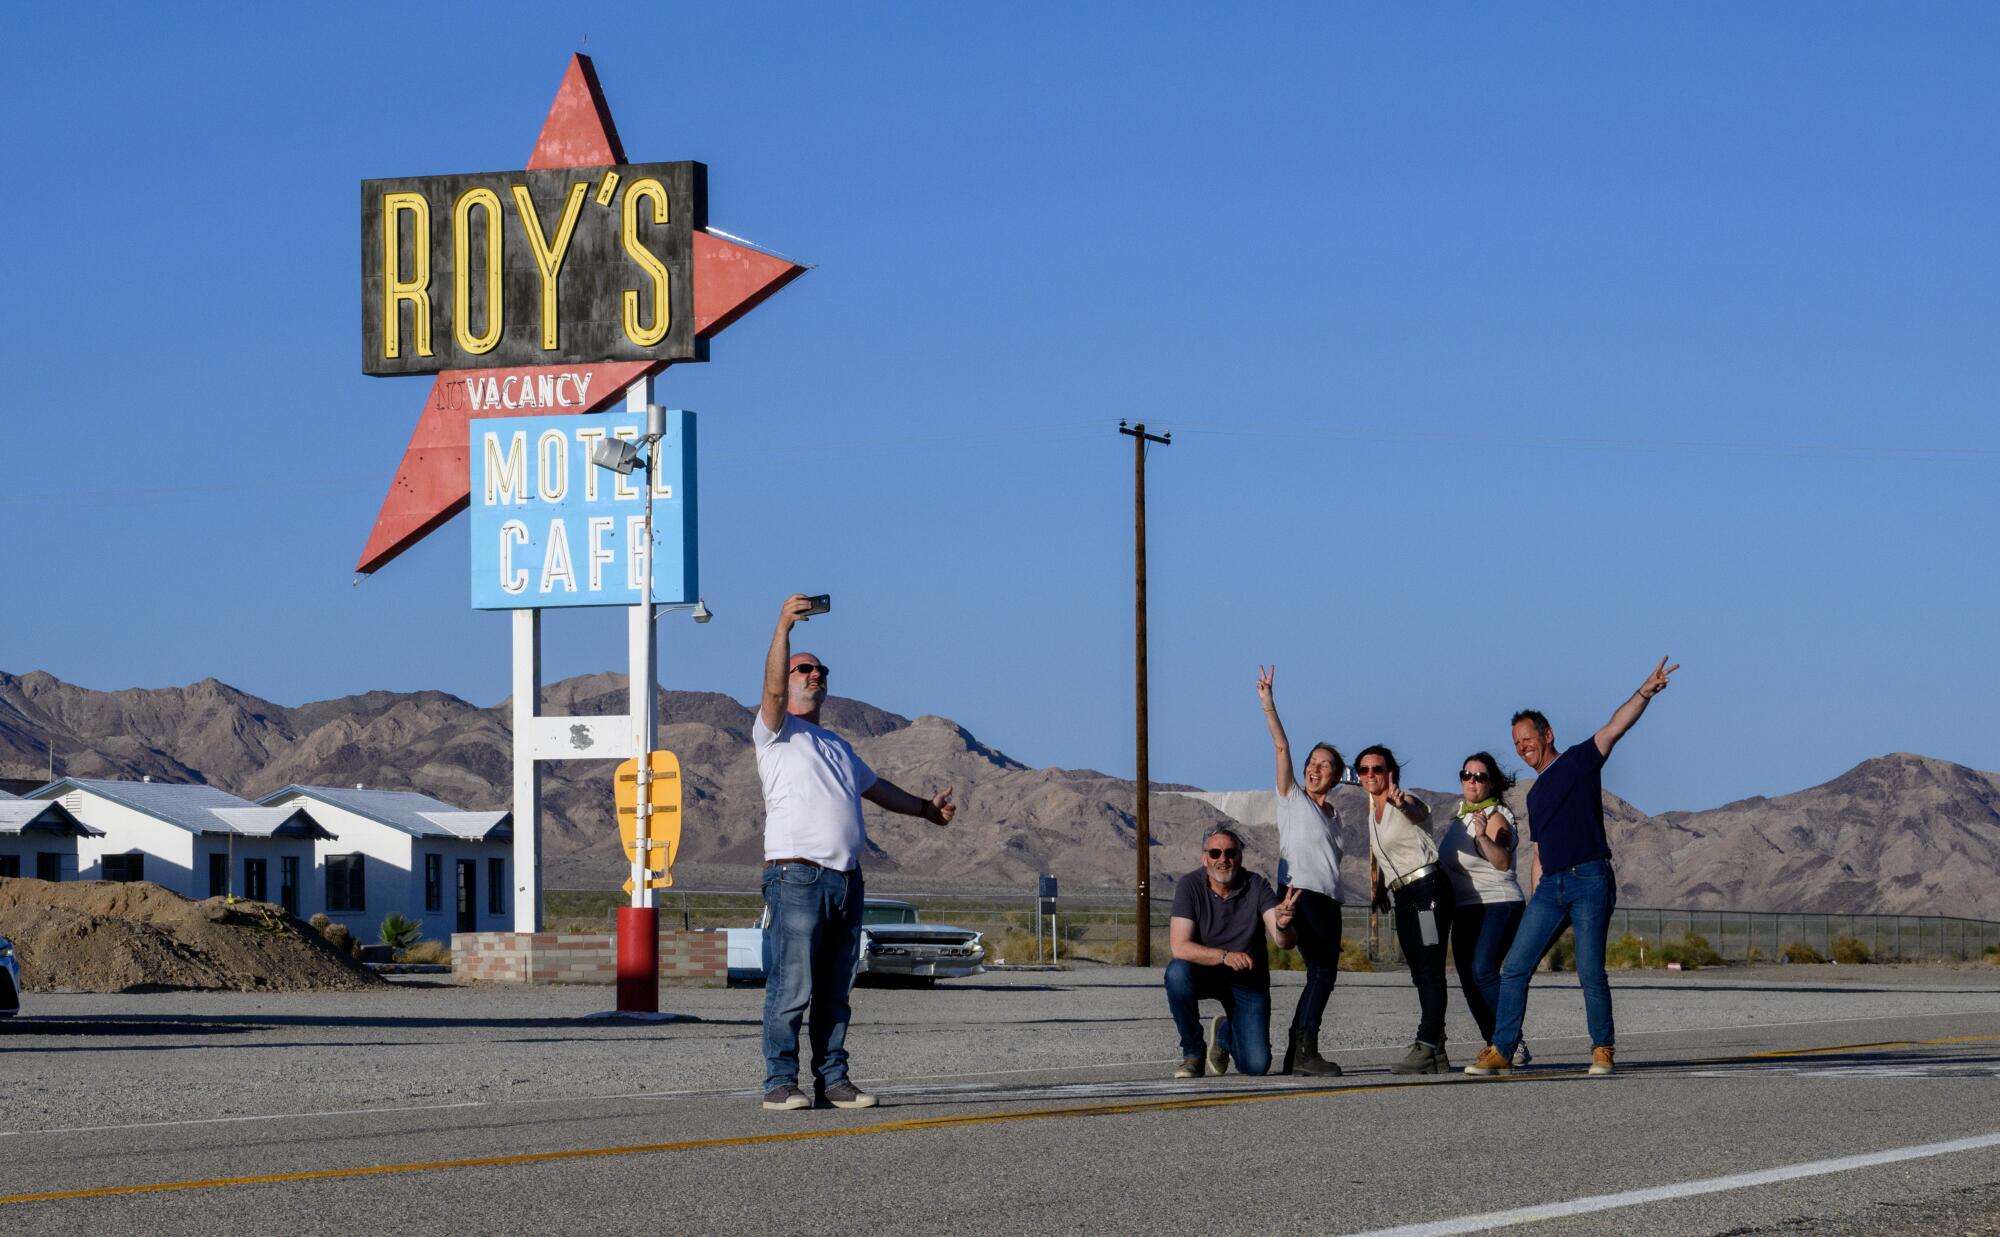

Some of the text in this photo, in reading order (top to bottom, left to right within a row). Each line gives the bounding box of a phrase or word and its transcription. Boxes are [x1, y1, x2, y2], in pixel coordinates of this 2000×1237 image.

[383, 170, 670, 358] ROY'S
[466, 372, 592, 410] VACANCY
[484, 426, 672, 506] MOTEL
[499, 515, 655, 595] CAFE
